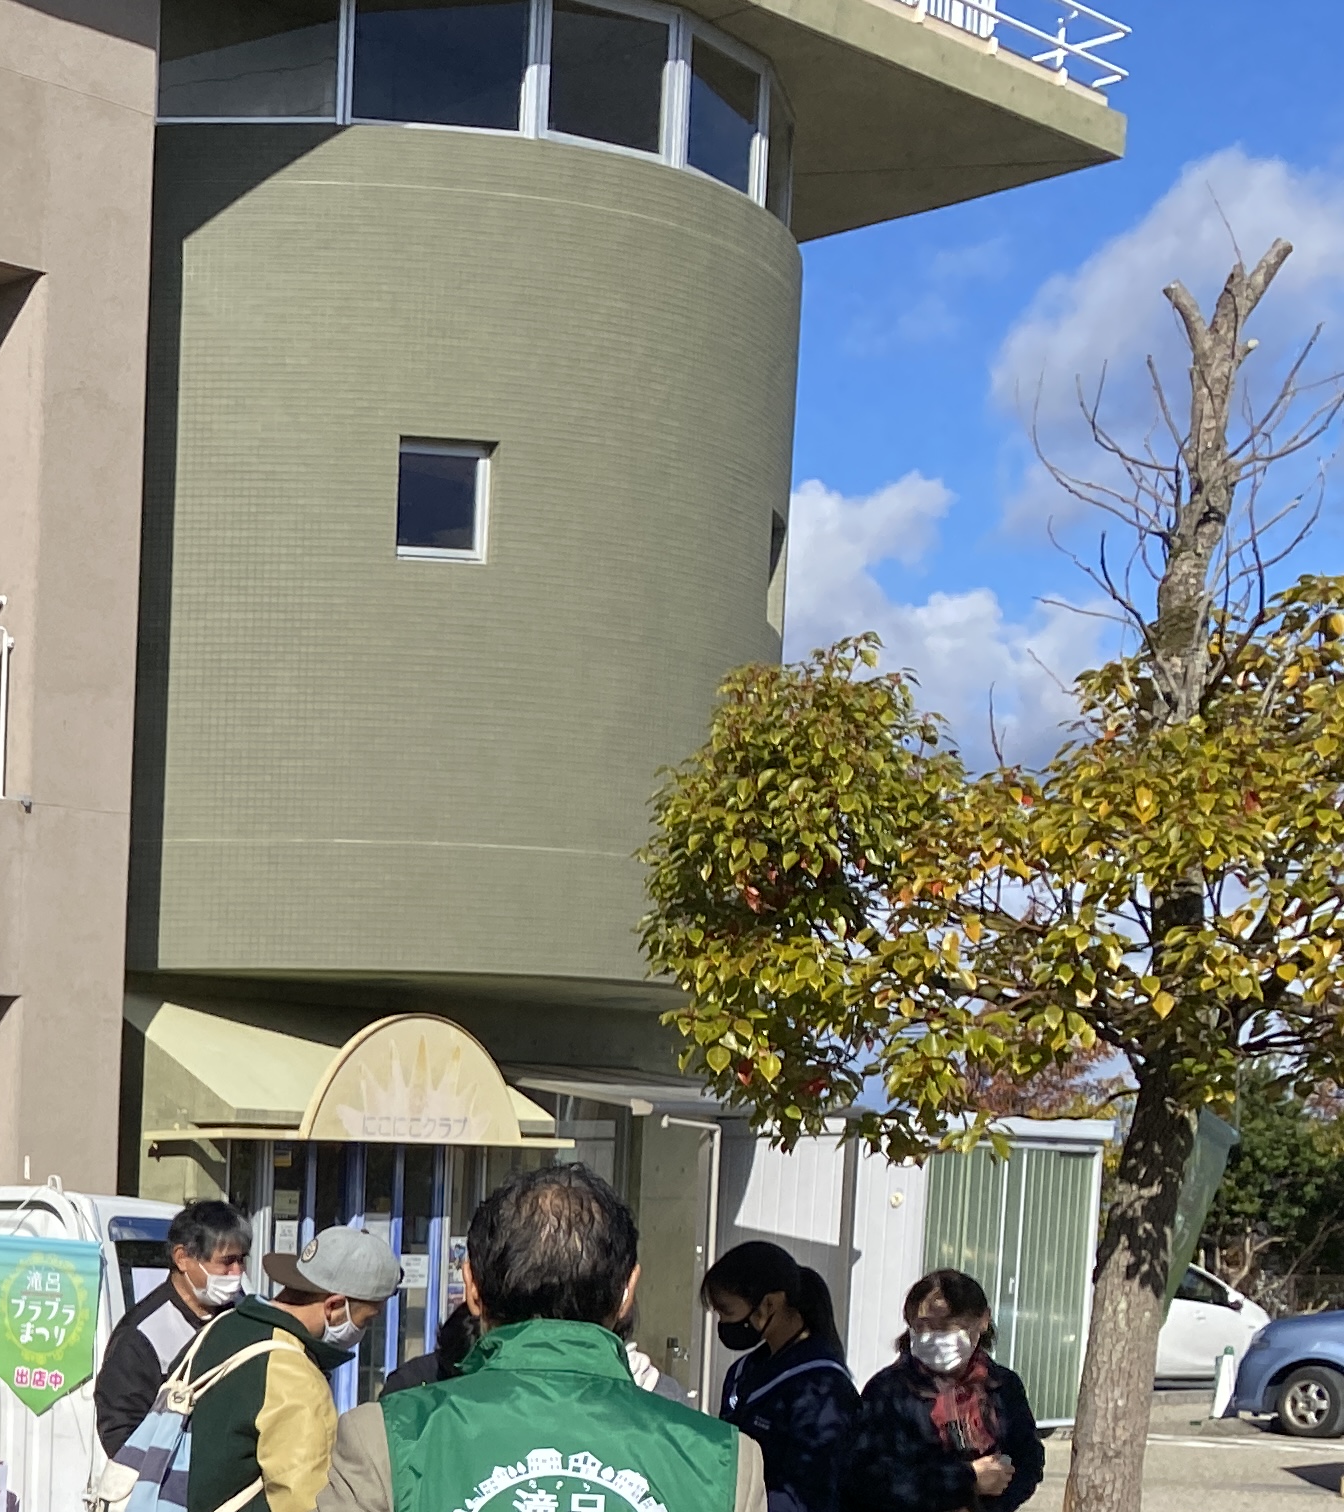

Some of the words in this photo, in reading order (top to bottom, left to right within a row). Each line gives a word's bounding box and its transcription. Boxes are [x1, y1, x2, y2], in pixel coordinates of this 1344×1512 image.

[362, 1116, 471, 1139] にこにこクラブ
[26, 1271, 61, 1292] 滝呂
[10, 1295, 75, 1326] ブラブラ
[19, 1321, 66, 1347] まつり
[15, 1367, 63, 1391] 出店中
